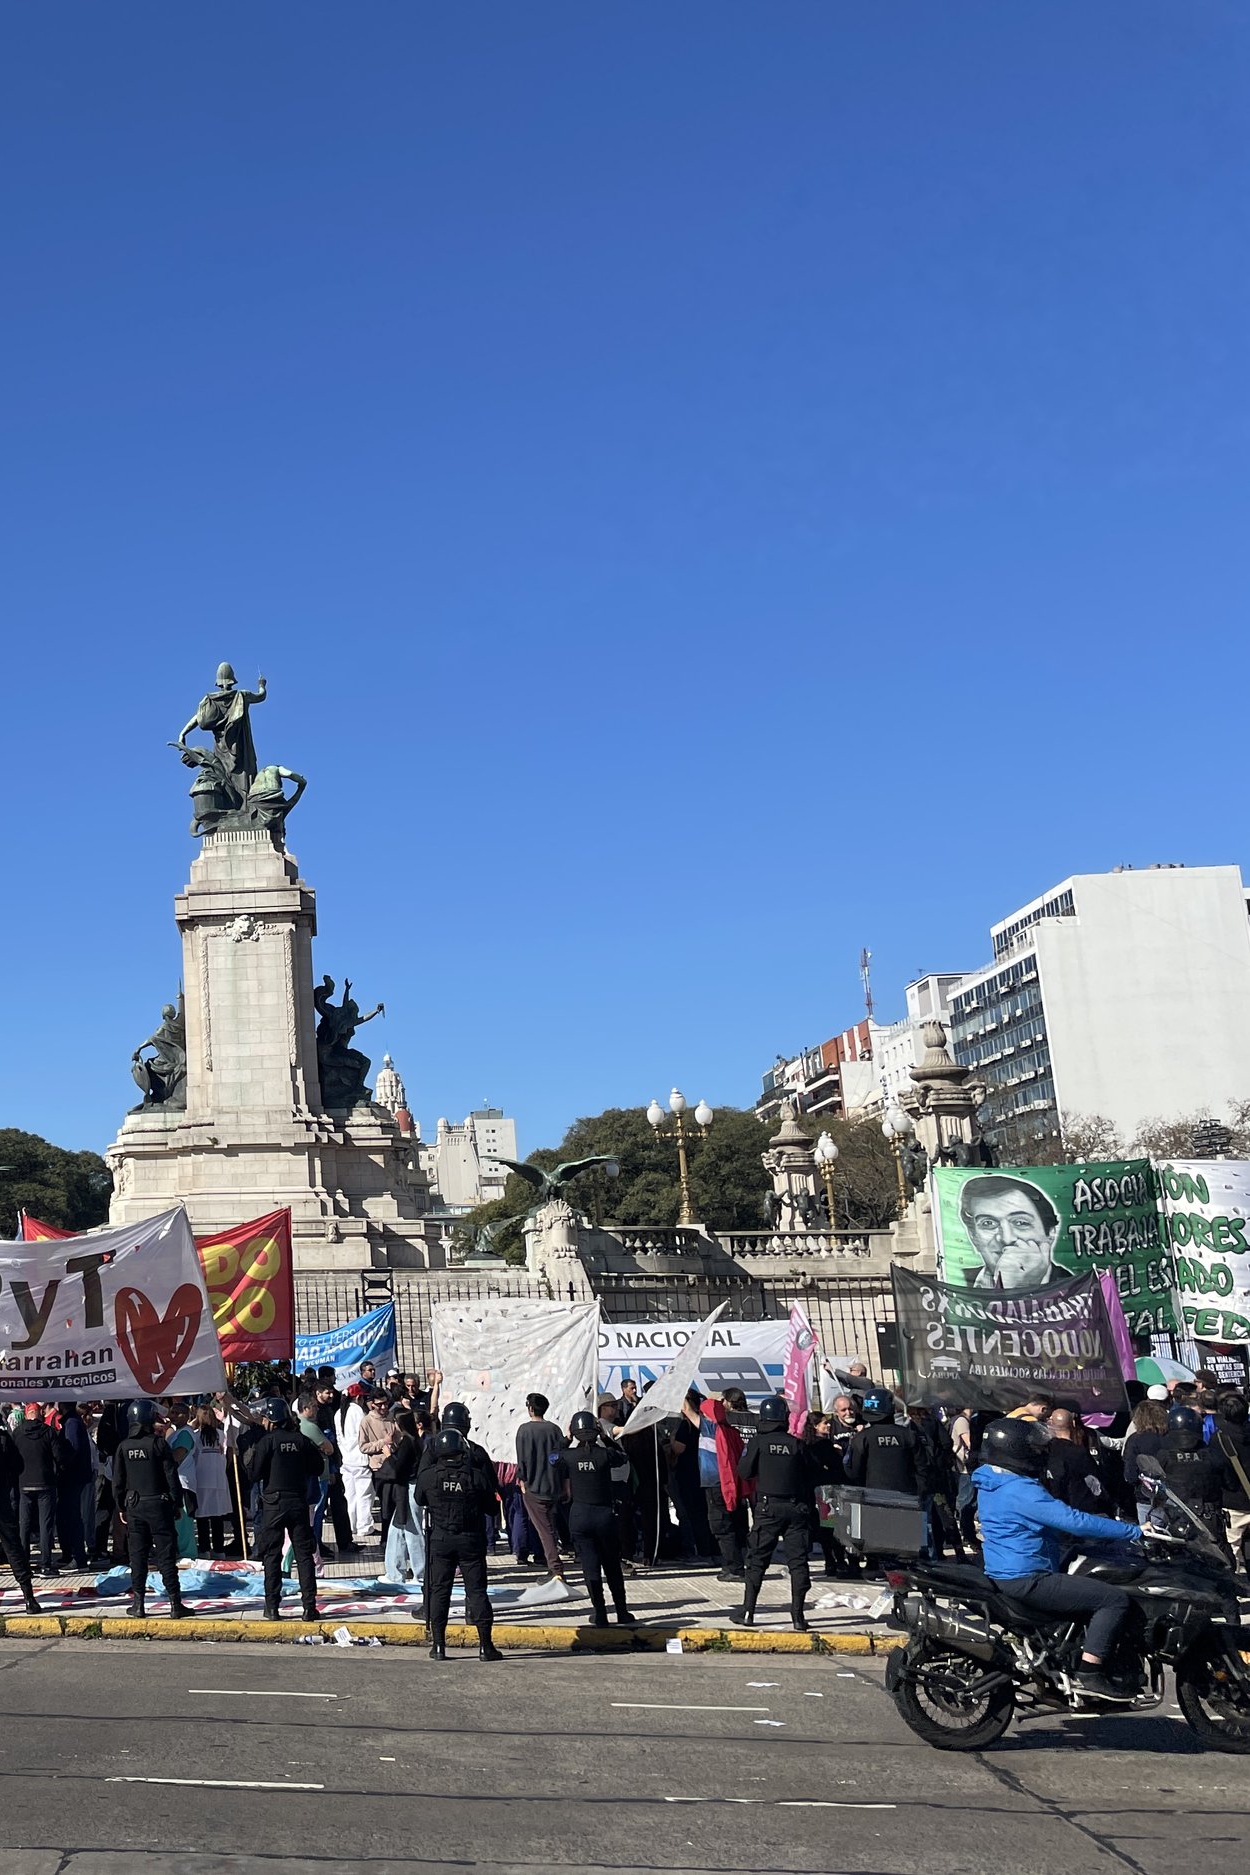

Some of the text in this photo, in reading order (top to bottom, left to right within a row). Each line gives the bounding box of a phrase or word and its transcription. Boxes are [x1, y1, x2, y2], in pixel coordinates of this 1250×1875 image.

[1097, 1257, 1234, 1298] EL ESADO
[618, 1329, 740, 1348] NACIOAL
[47, 1377, 54, 1388] y
[57, 1369, 115, 1386] Técnicos
[877, 1436, 899, 1446] PFA
[280, 1442, 297, 1453] PFA
[769, 1444, 790, 1455] PFA
[128, 1449, 146, 1460] PFA
[577, 1461, 595, 1472] PFA
[442, 1481, 463, 1493] PFA
